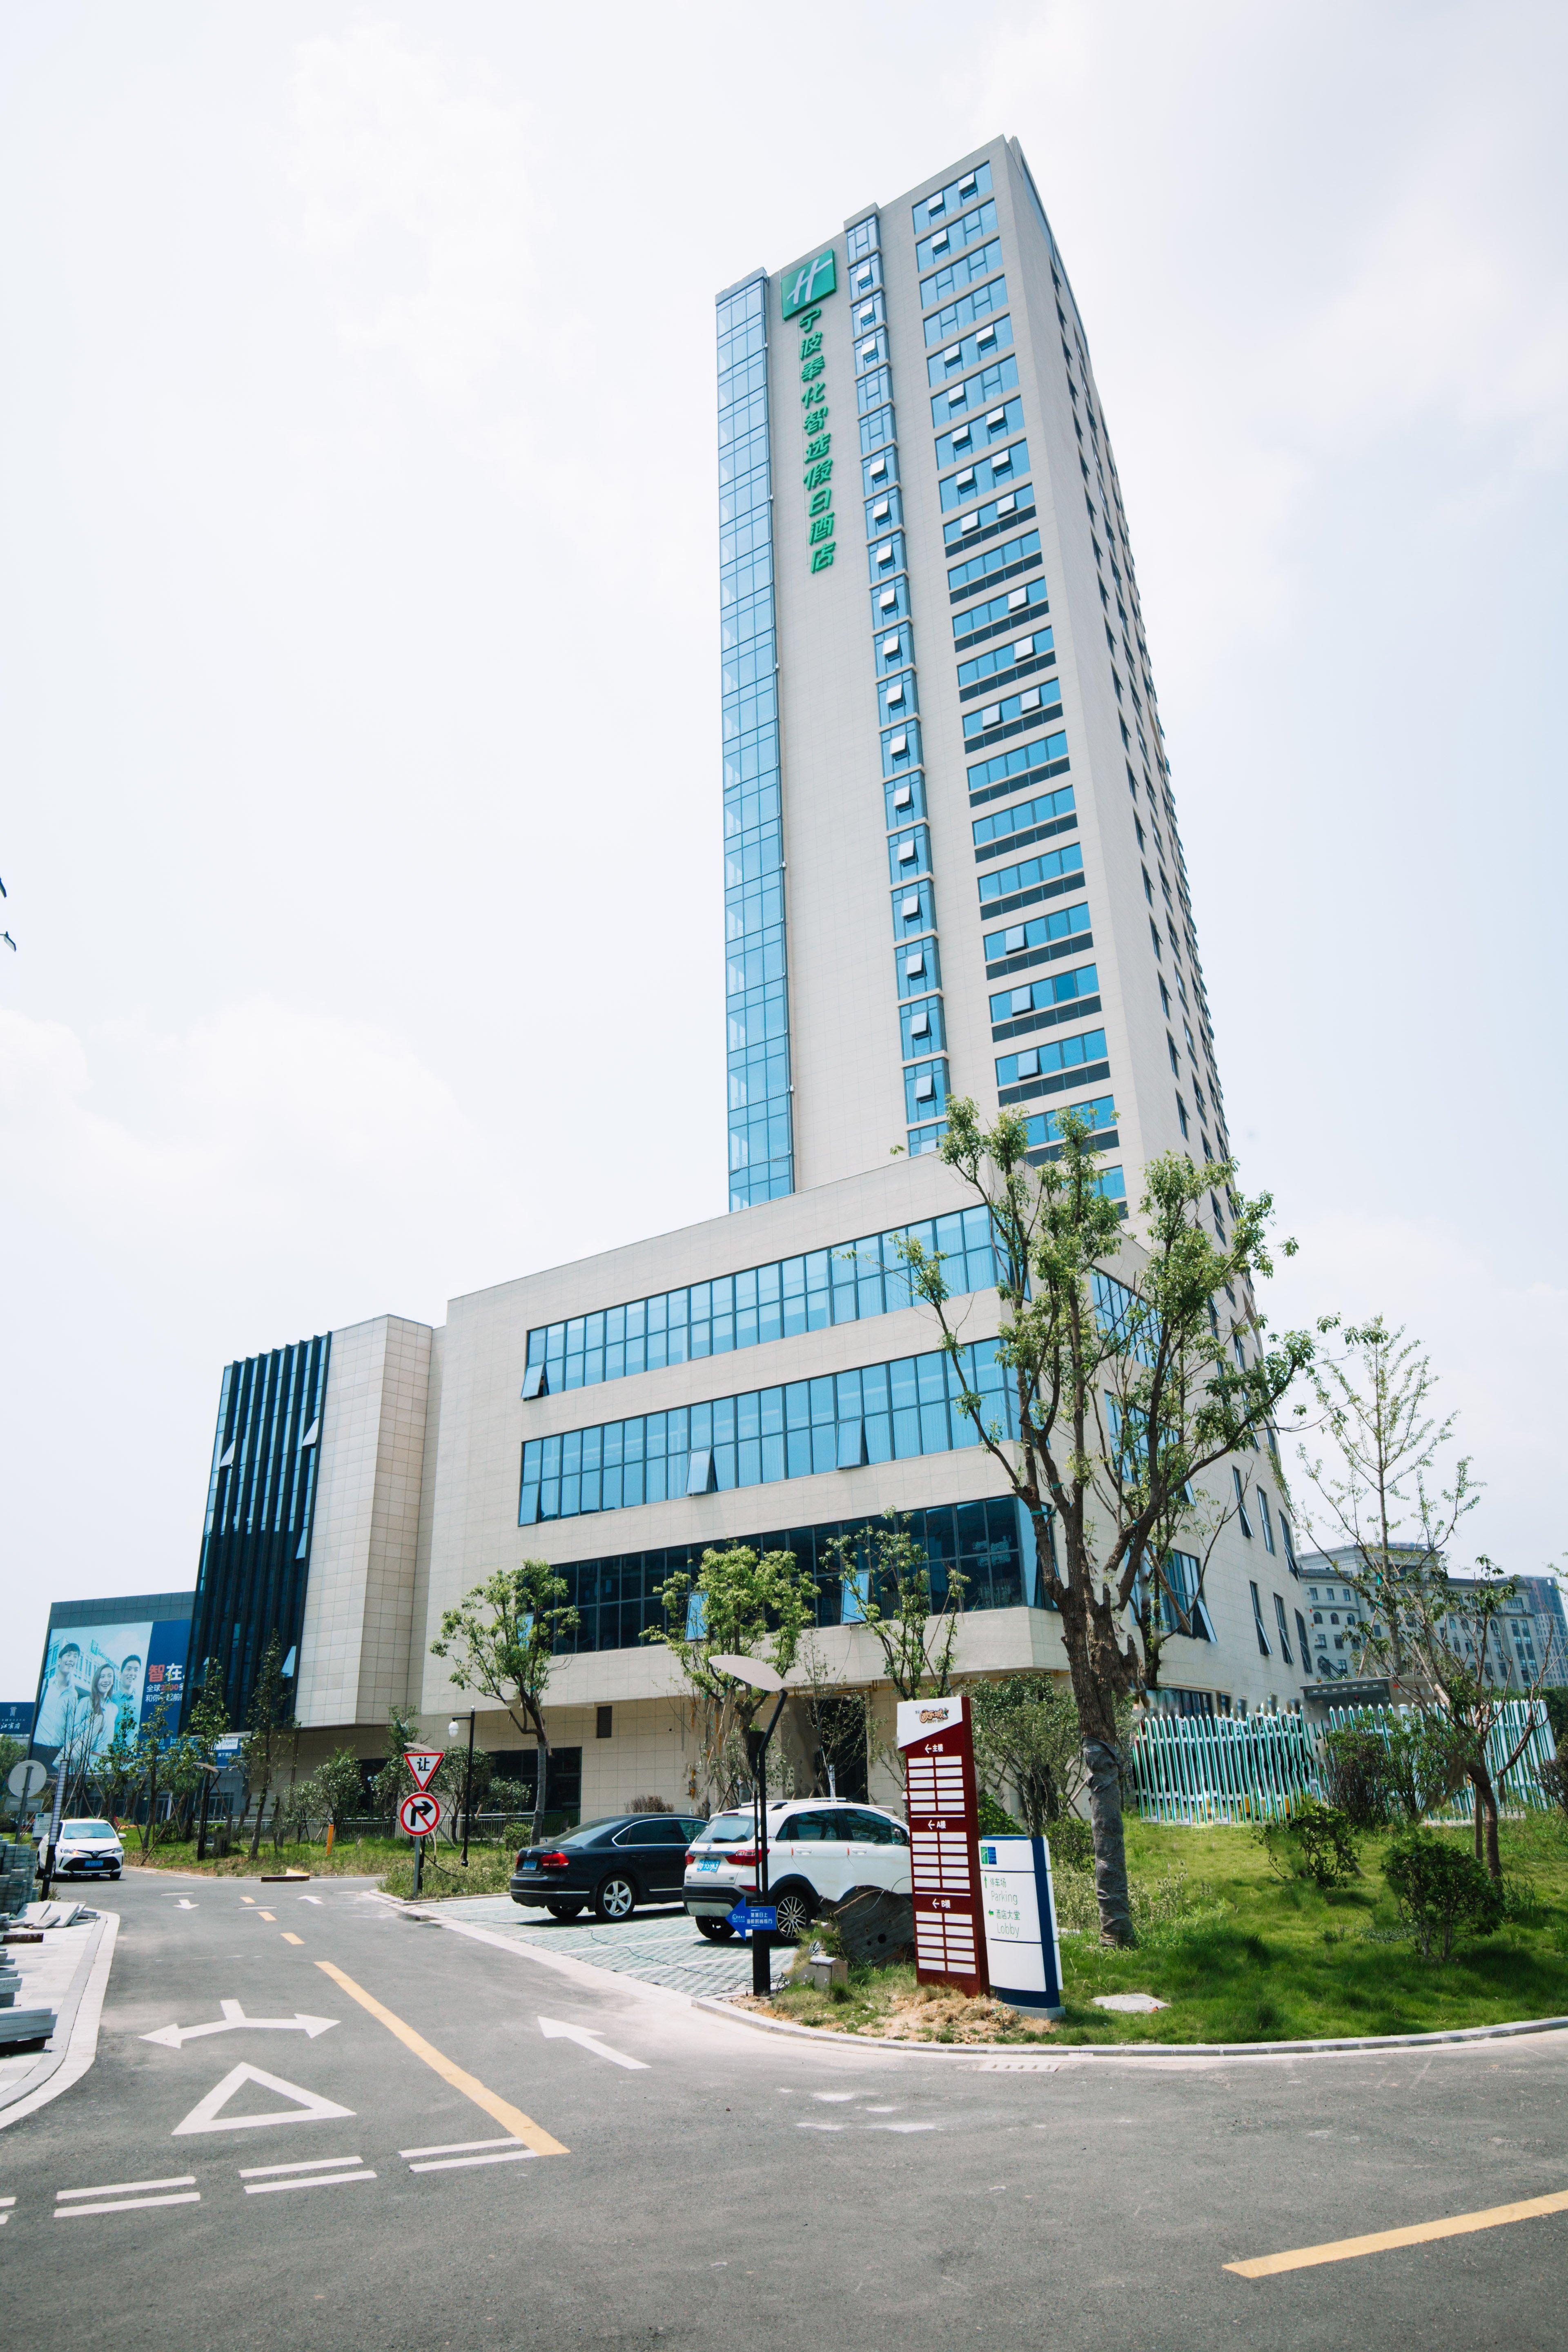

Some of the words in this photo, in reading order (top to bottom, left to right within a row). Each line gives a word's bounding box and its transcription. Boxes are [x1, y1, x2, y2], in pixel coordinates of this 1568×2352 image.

[799, 307, 836, 574] 宁波奉化智选假日酒店
[148, 1663, 185, 1682] 智在
[147, 1683, 184, 1692] 全球200多
[417, 1757, 430, 1771] 让
[937, 1820, 946, 1829] A楼
[990, 1878, 1006, 1888] 停车场
[991, 1891, 1018, 1905] Parking
[941, 1900, 951, 1909] B楼
[996, 1909, 1020, 1920] 酒店大堂
[997, 1922, 1019, 1938] Lobby
